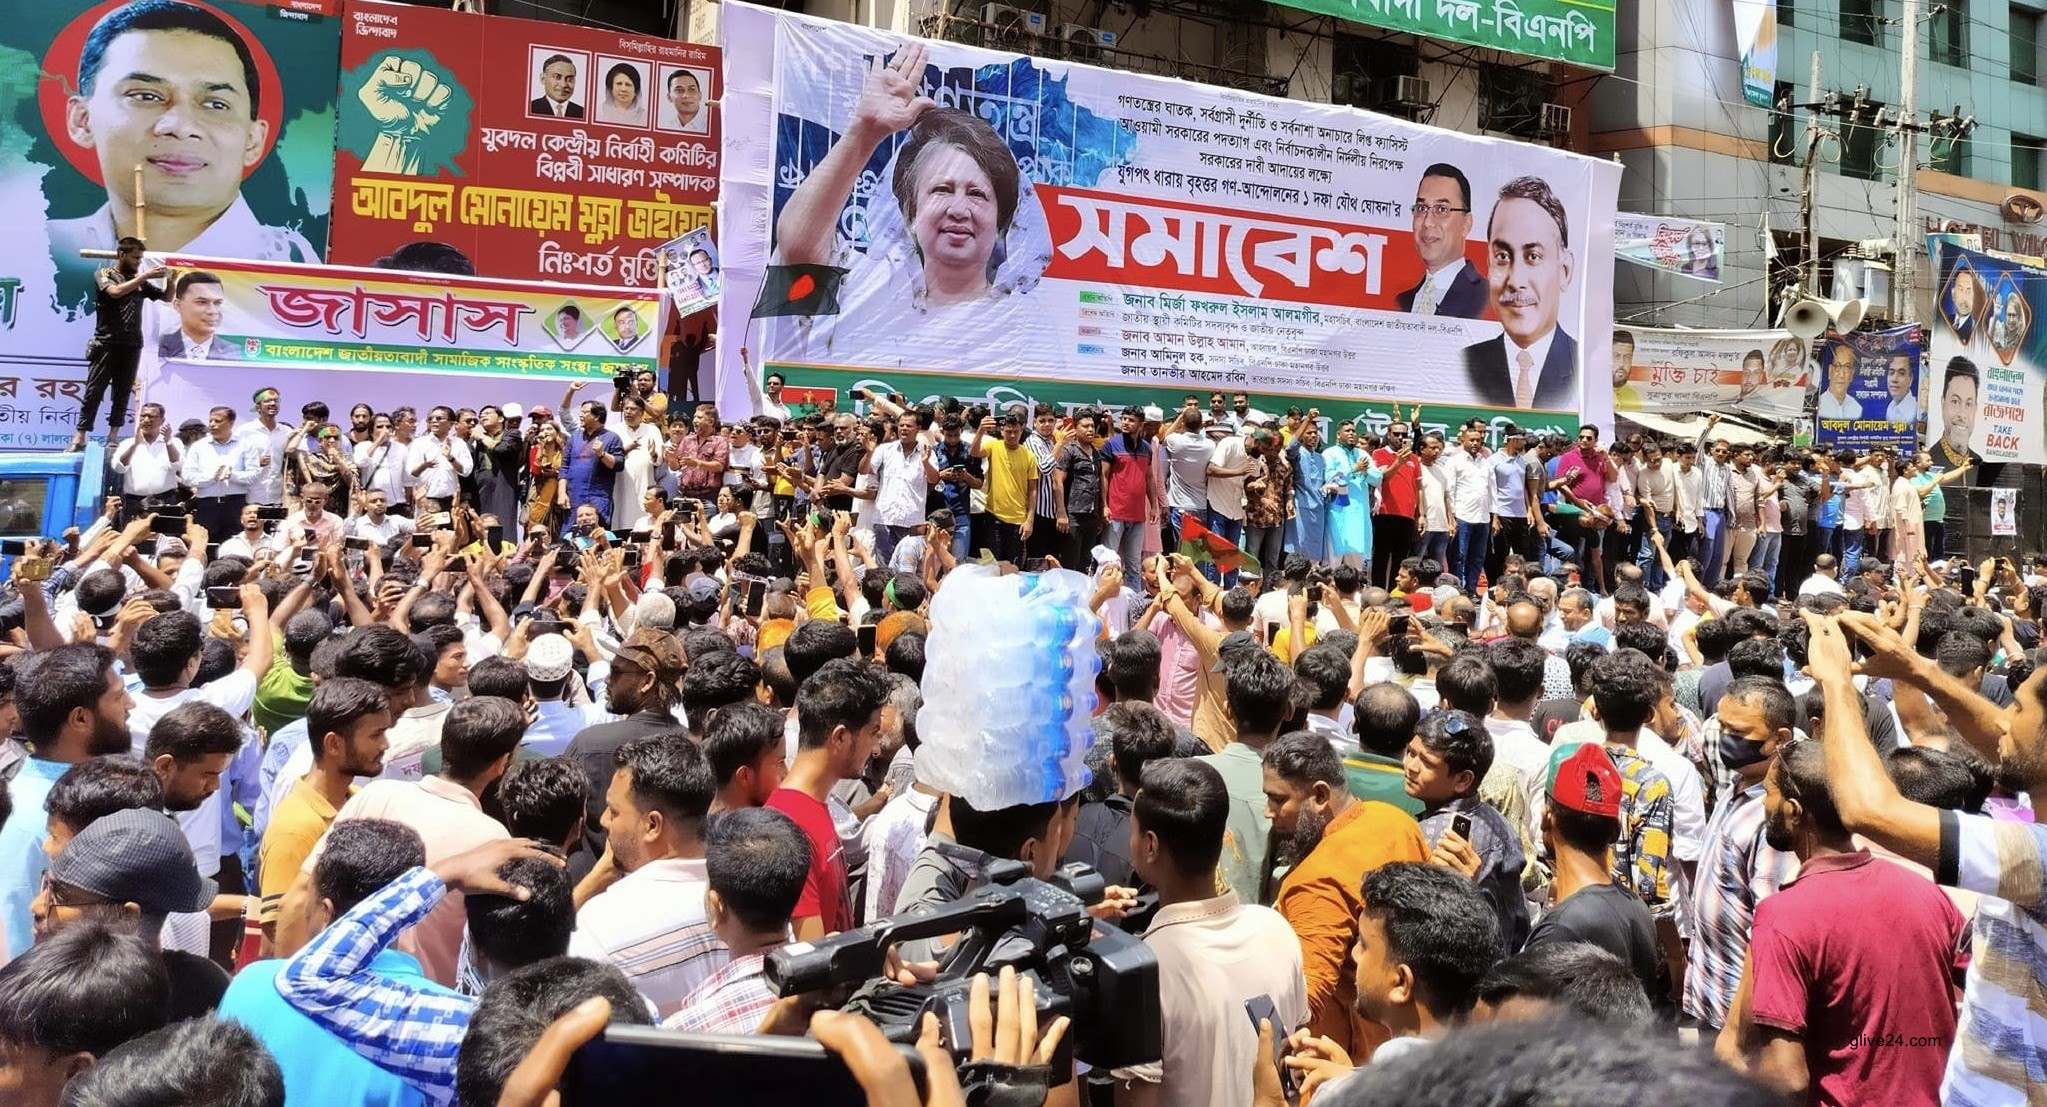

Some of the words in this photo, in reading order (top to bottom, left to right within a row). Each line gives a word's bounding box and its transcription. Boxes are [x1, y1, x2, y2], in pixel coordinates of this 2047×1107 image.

[353, 11, 398, 25] বাংলাদেশ
[356, 22, 398, 38] জিন্দাবাদ
[1118, 94, 1162, 113] গণতন্ত্রের
[1200, 105, 1236, 125] সর্বগ্রাসী
[1269, 120, 1278, 131] ও
[1281, 117, 1314, 138] সর্বনাশা
[1317, 126, 1353, 144] অনাচারে
[1375, 135, 1409, 153] ফ্যাসিস্ট
[481, 127, 537, 152] যুবদল
[542, 128, 600, 159] কেন্দ্রীয়
[605, 134, 656, 163] নির্বাহী
[659, 142, 717, 170] কমিটির
[1119, 117, 1162, 137] আওয়ামী
[1165, 124, 1210, 144] সরকারের
[1213, 132, 1250, 151] পদত্যাগ
[1253, 138, 1273, 154] এবং
[1275, 138, 1333, 163] নির্বাচনকালীন
[1336, 147, 1367, 168] নির্দলীয়
[1369, 152, 1405, 172] নিরপেক্ষ
[588, 164, 645, 188] সাধারণ
[649, 170, 717, 193] সম্পাদক
[1199, 151, 1243, 171] সরকারের
[1245, 156, 1265, 174] দাবী
[1267, 161, 1306, 180] আদায়ের
[1308, 168, 1333, 184] লক্ষ্যে
[1117, 164, 1151, 186] যুগপৎ
[1153, 169, 1183, 189] ধারায়
[1186, 175, 1218, 197] বৃহত্তর
[1221, 179, 1300, 203] গণ-আন্দোলনের
[1303, 191, 1309, 206] ১
[1313, 191, 1333, 209] দফা
[1336, 191, 1358, 212] যৌথ
[351, 177, 455, 233] আবদুল
[460, 185, 574, 237] মোনায়েম
[578, 193, 622, 246] মুন্না
[538, 240, 619, 277] নিঃশর্ত
[1057, 194, 1388, 298] সমাবেশ
[255, 283, 537, 346] জাসাস
[1123, 293, 1155, 309] জনাব
[1159, 292, 1186, 312] মির্জা
[1190, 300, 1228, 317] ফখরুল
[1232, 299, 1268, 319] ইসলাম
[1174, 314, 1202, 327] কমিটির
[1121, 330, 1150, 343] জনাব
[1153, 332, 1184, 346] আমান
[1187, 332, 1215, 349] উল্লাহ
[265, 343, 334, 361] বাংলাদেশ
[338, 345, 428, 366] জাতীয়তাবাদী
[432, 351, 493, 369] সামাজিক
[1121, 347, 1147, 360] জনাব
[1151, 347, 1186, 365] আমিনুল
[1120, 365, 1147, 377] জনাব
[1150, 364, 1185, 380] তানভীর
[1189, 369, 1223, 384] আহমেদ
[1649, 361, 1689, 388] মুক্তি
[1693, 362, 1721, 388] চাই
[1986, 434, 2020, 450] BACK
[1993, 425, 2013, 435] TAKE
